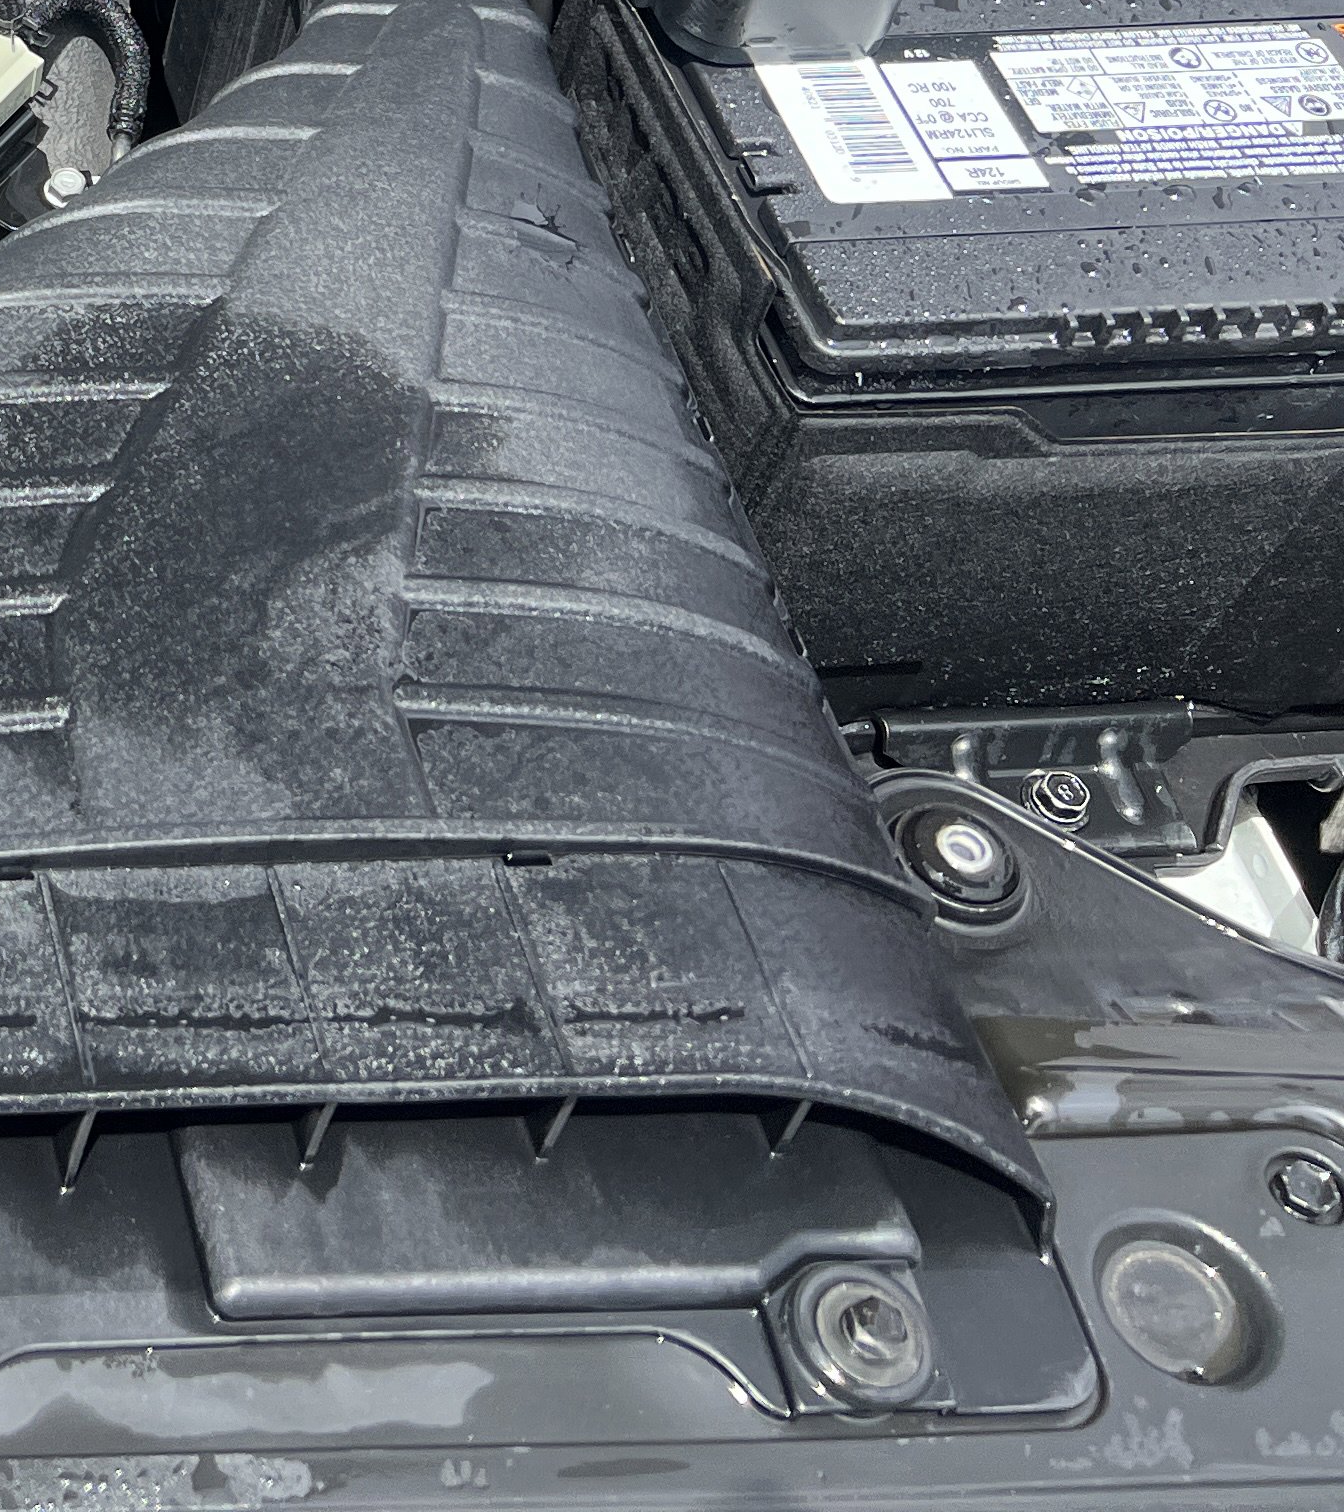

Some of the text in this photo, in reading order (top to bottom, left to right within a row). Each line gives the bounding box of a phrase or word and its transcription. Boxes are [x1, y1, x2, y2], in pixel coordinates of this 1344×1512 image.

[908, 82, 957, 94] 100 RC
[929, 98, 956, 108] 700
[940, 110, 954, 124] @
[957, 112, 989, 123] CCA
[1050, 110, 1114, 120] IMMEDIATELY
[1149, 108, 1195, 117] SULFURIC
[925, 127, 995, 141] SLI124RM
[1114, 123, 1286, 141] DANGER/POISON
[942, 145, 1000, 154] PART NO.
[965, 167, 1005, 179] 124R
